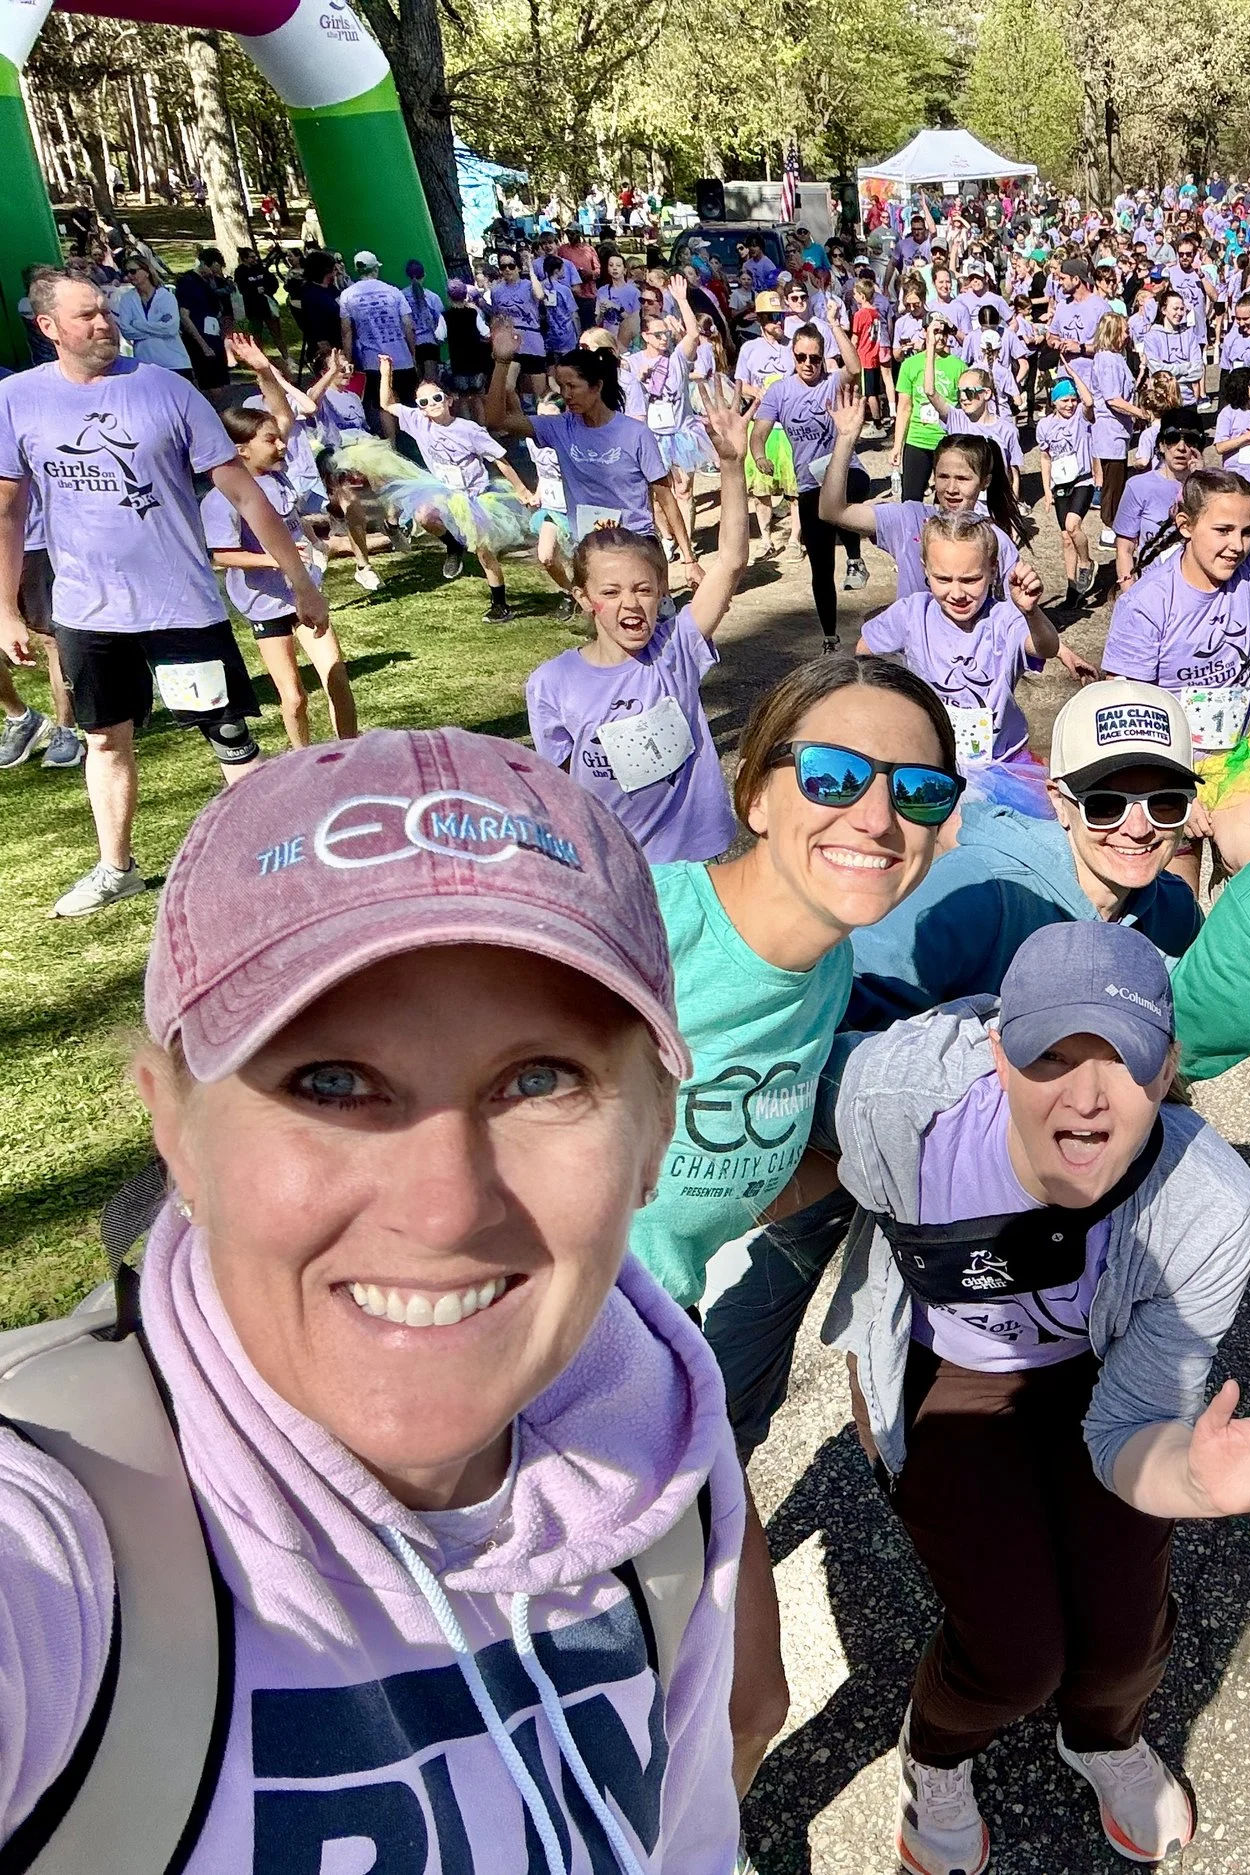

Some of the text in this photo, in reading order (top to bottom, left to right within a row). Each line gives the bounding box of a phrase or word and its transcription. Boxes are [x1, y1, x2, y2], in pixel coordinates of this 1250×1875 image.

[320, 14, 350, 30] Girls
[337, 30, 360, 41] run
[657, 413, 663, 423] 1
[43, 461, 116, 479] Girls on
[1061, 466, 1067, 477] 1
[57, 476, 120, 493] the run
[1177, 660, 1225, 681] Girls
[1203, 667, 1237, 686] run
[188, 682, 199, 698] 1
[1098, 708, 1168, 723] EAU CLAIRE
[1211, 710, 1224, 733] 1
[1099, 719, 1170, 734] MARATHON
[1100, 729, 1169, 741] RACE COMMITTEE
[644, 737, 663, 760] 1
[592, 769, 608, 778] the
[256, 836, 306, 876] THE
[1119, 987, 1162, 1017] Columbia
[670, 1155, 762, 1180] CHARITY
[680, 1186, 724, 1198] PRESENTED
[961, 1275, 995, 1288] Girls
